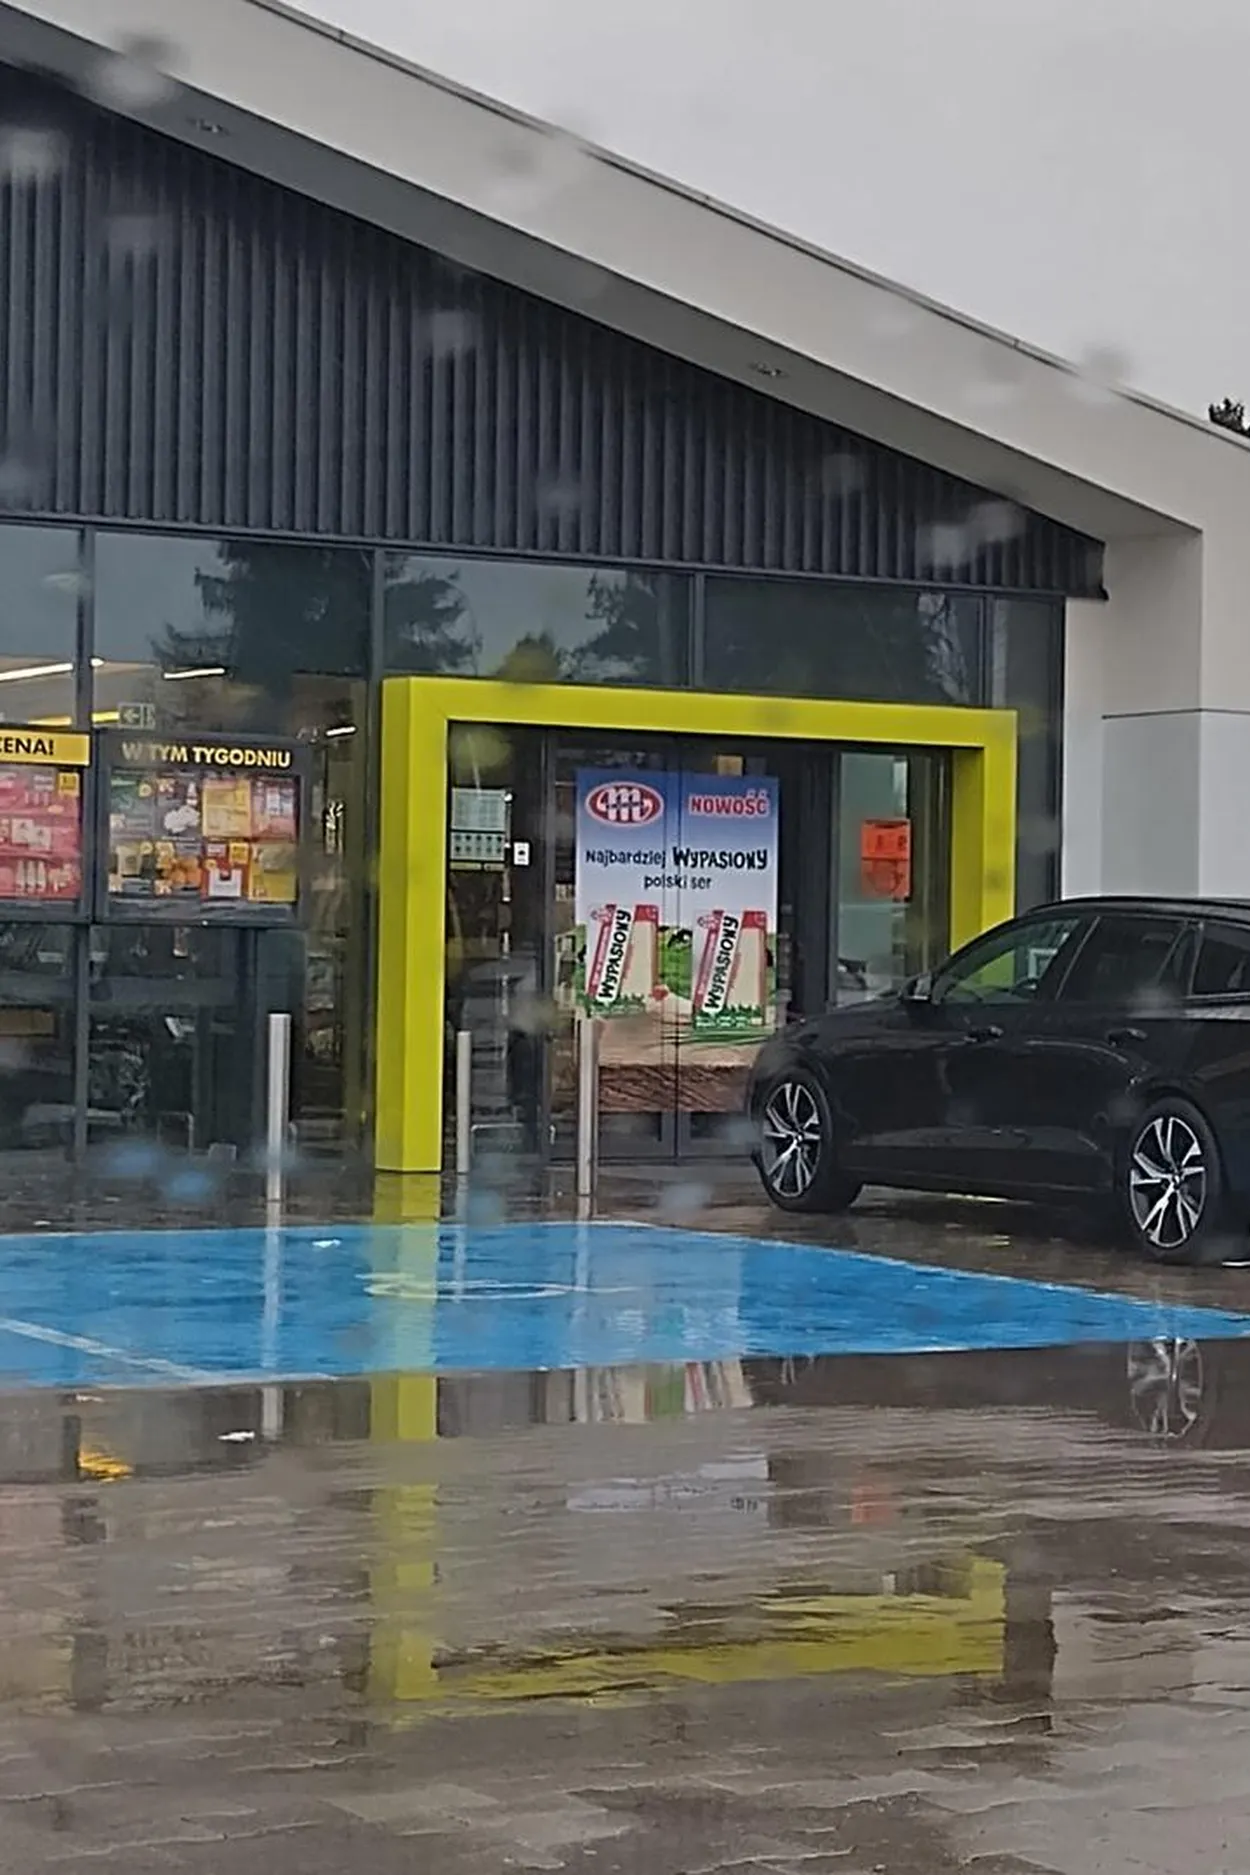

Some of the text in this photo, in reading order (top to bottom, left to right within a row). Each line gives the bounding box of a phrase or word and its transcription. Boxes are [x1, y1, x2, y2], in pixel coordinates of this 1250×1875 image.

[0, 736, 54, 756] ENA!
[122, 741, 291, 767] W TYM TYGODNIU
[689, 788, 769, 816] NOWOŚĆ
[585, 850, 666, 869] Najbardziej
[643, 874, 712, 890] polski ser
